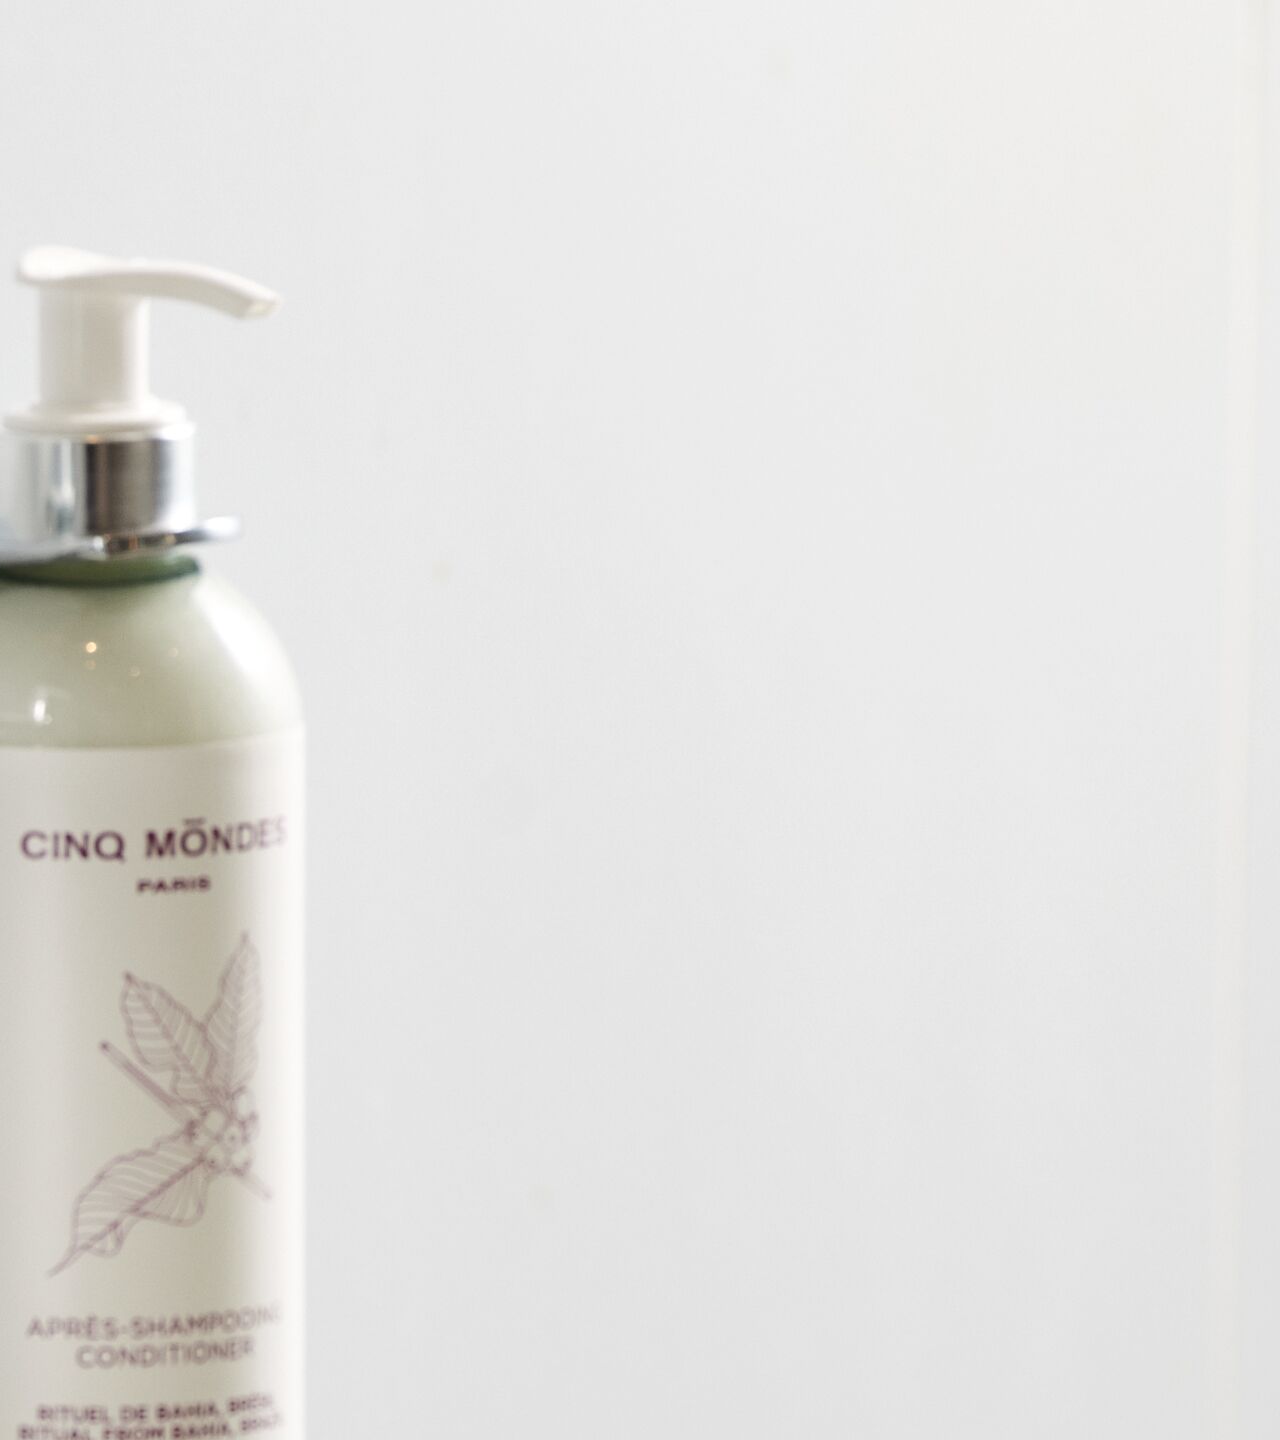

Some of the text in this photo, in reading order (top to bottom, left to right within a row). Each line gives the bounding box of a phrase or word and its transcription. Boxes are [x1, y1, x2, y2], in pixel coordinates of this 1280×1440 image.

[20, 830, 126, 863] CINQ
[136, 874, 211, 894] PARIS
[76, 1336, 254, 1368] CONDITIONER
